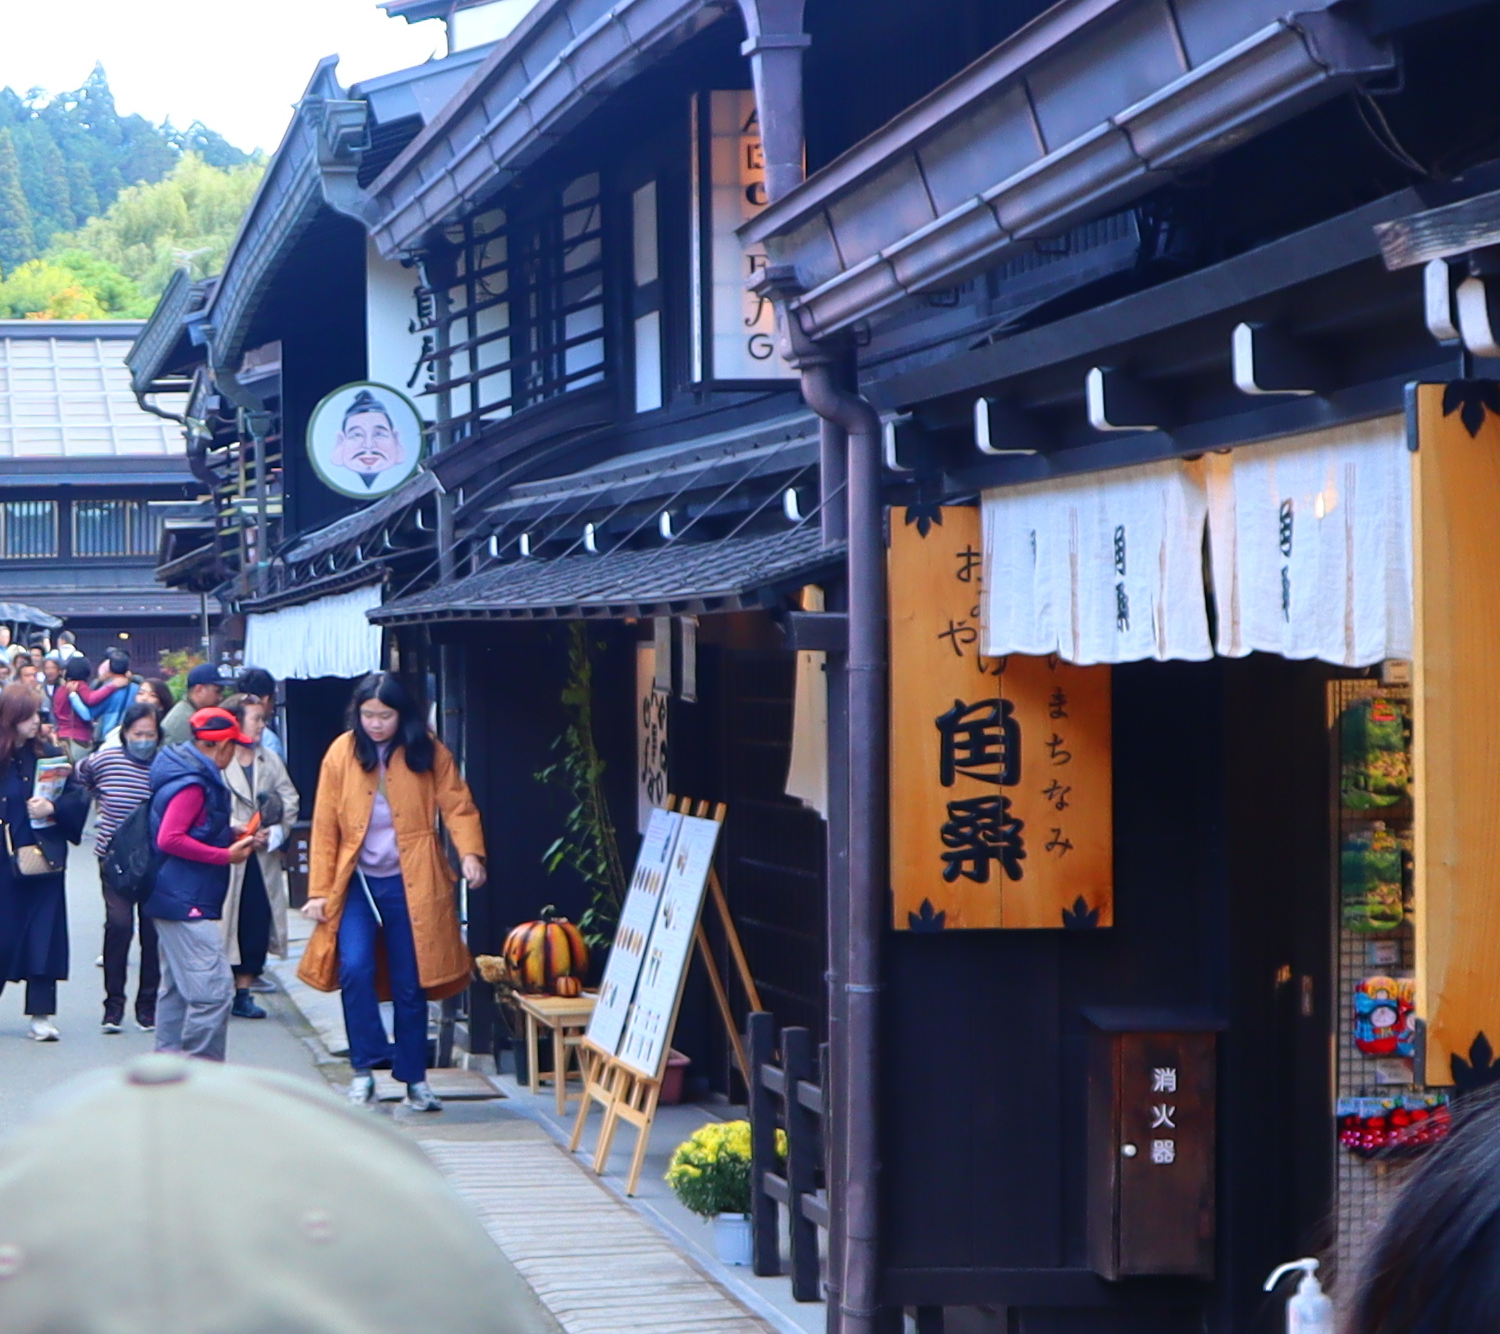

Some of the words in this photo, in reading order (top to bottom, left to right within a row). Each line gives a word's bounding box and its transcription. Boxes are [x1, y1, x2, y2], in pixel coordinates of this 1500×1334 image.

[936, 698, 1027, 884] 角桑
[1151, 1067, 1176, 1164] 消火器
